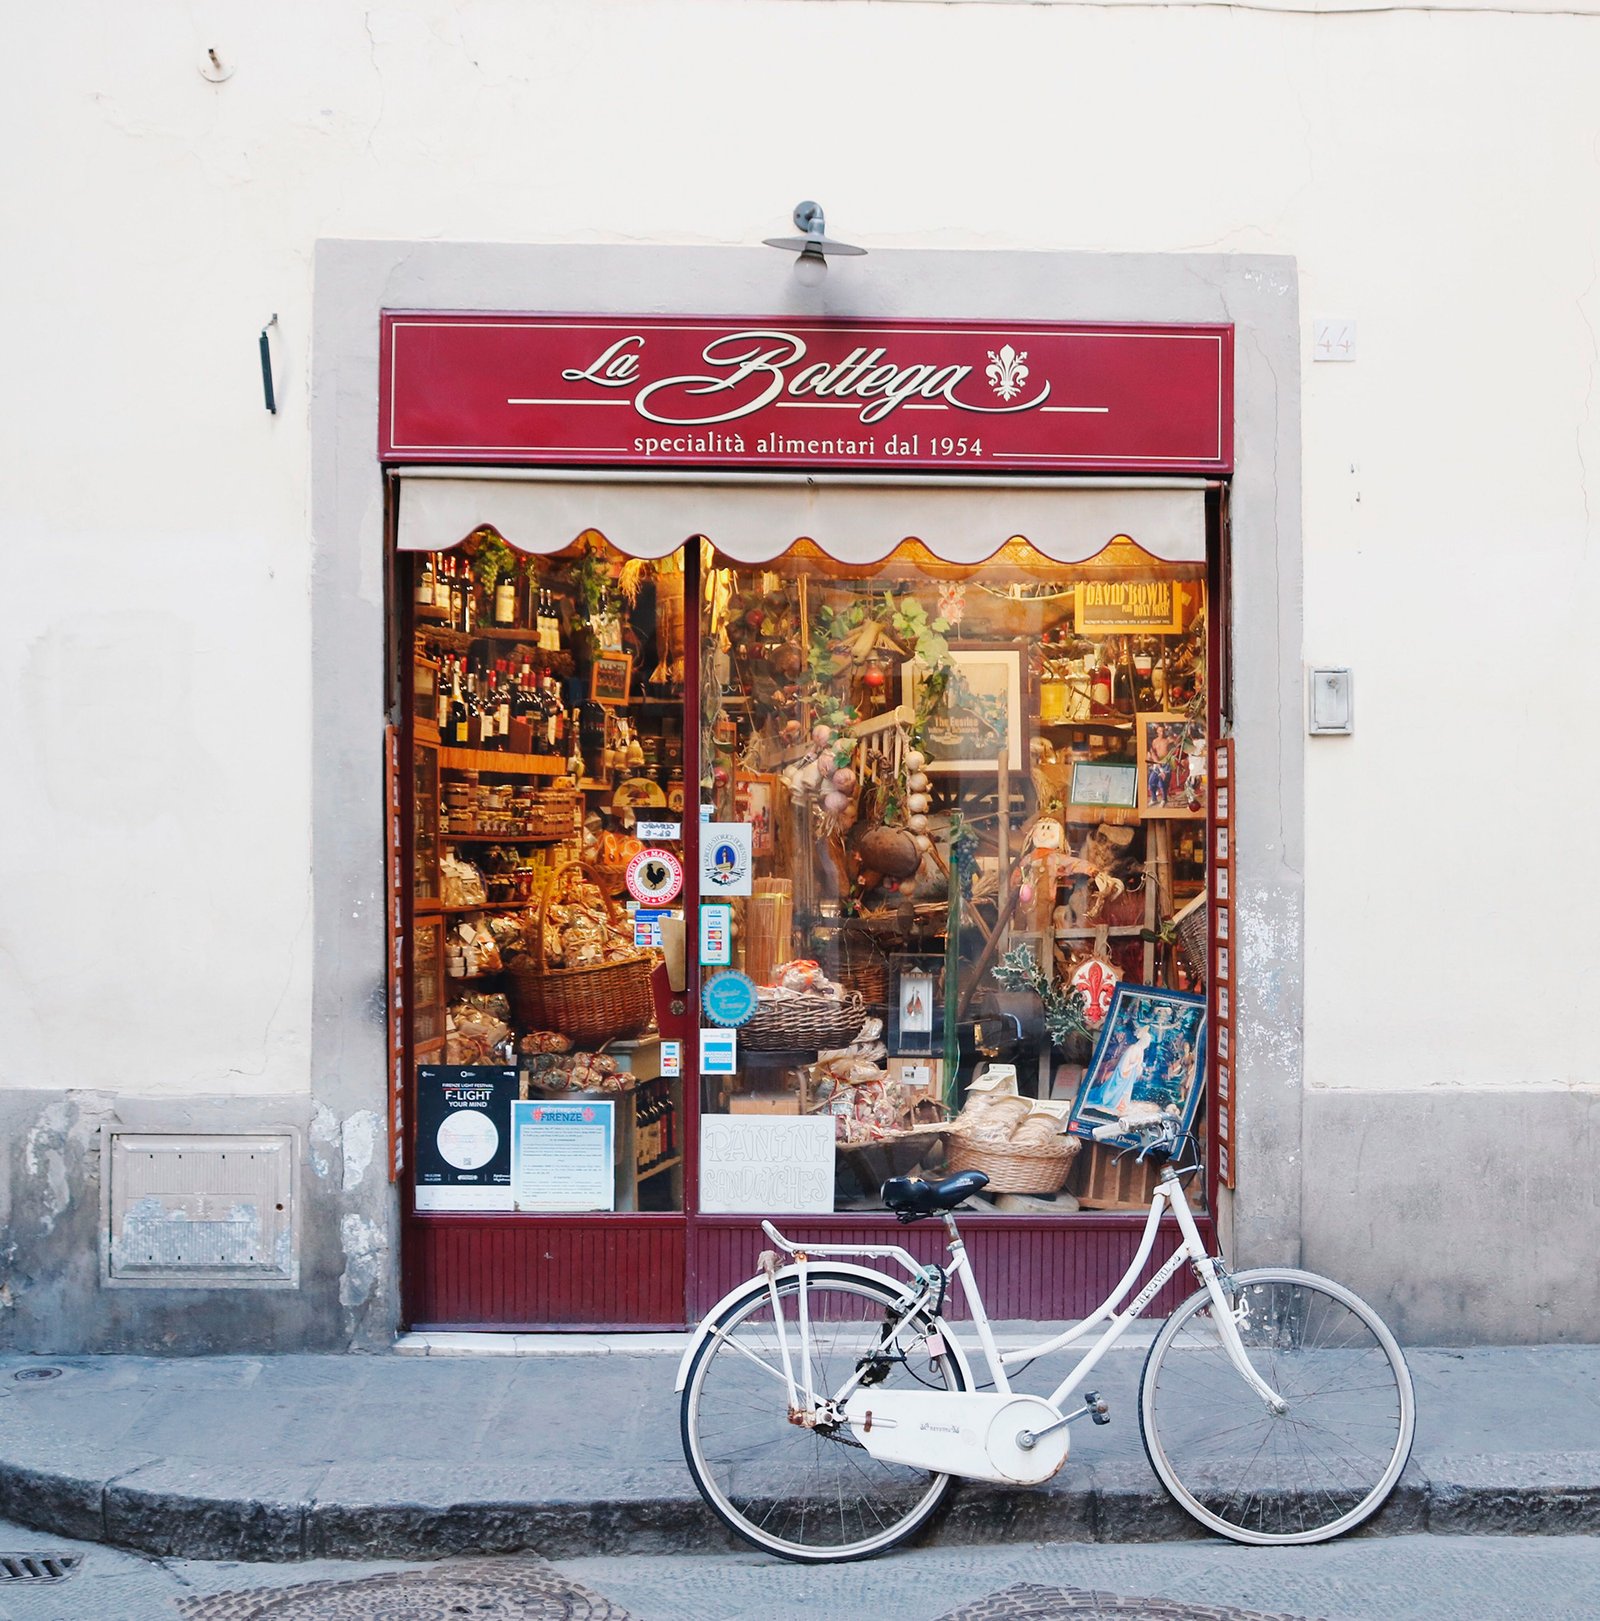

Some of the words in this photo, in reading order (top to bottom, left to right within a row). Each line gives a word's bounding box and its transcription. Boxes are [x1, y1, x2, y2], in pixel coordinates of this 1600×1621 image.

[561, 335, 646, 387] La
[634, 331, 1051, 426] Bottega
[634, 431, 745, 455] specialità
[757, 432, 874, 455] alimentari
[884, 434, 918, 456] dal
[930, 437, 982, 456] 1954
[1086, 583, 1126, 605] DAVID
[1128, 583, 1169, 605] BOWIE
[636, 852, 650, 864] DEL
[650, 850, 680, 874] MARCHIO
[445, 1091, 492, 1101] F-LIGHT
[541, 1113, 583, 1122] FIRENZE
